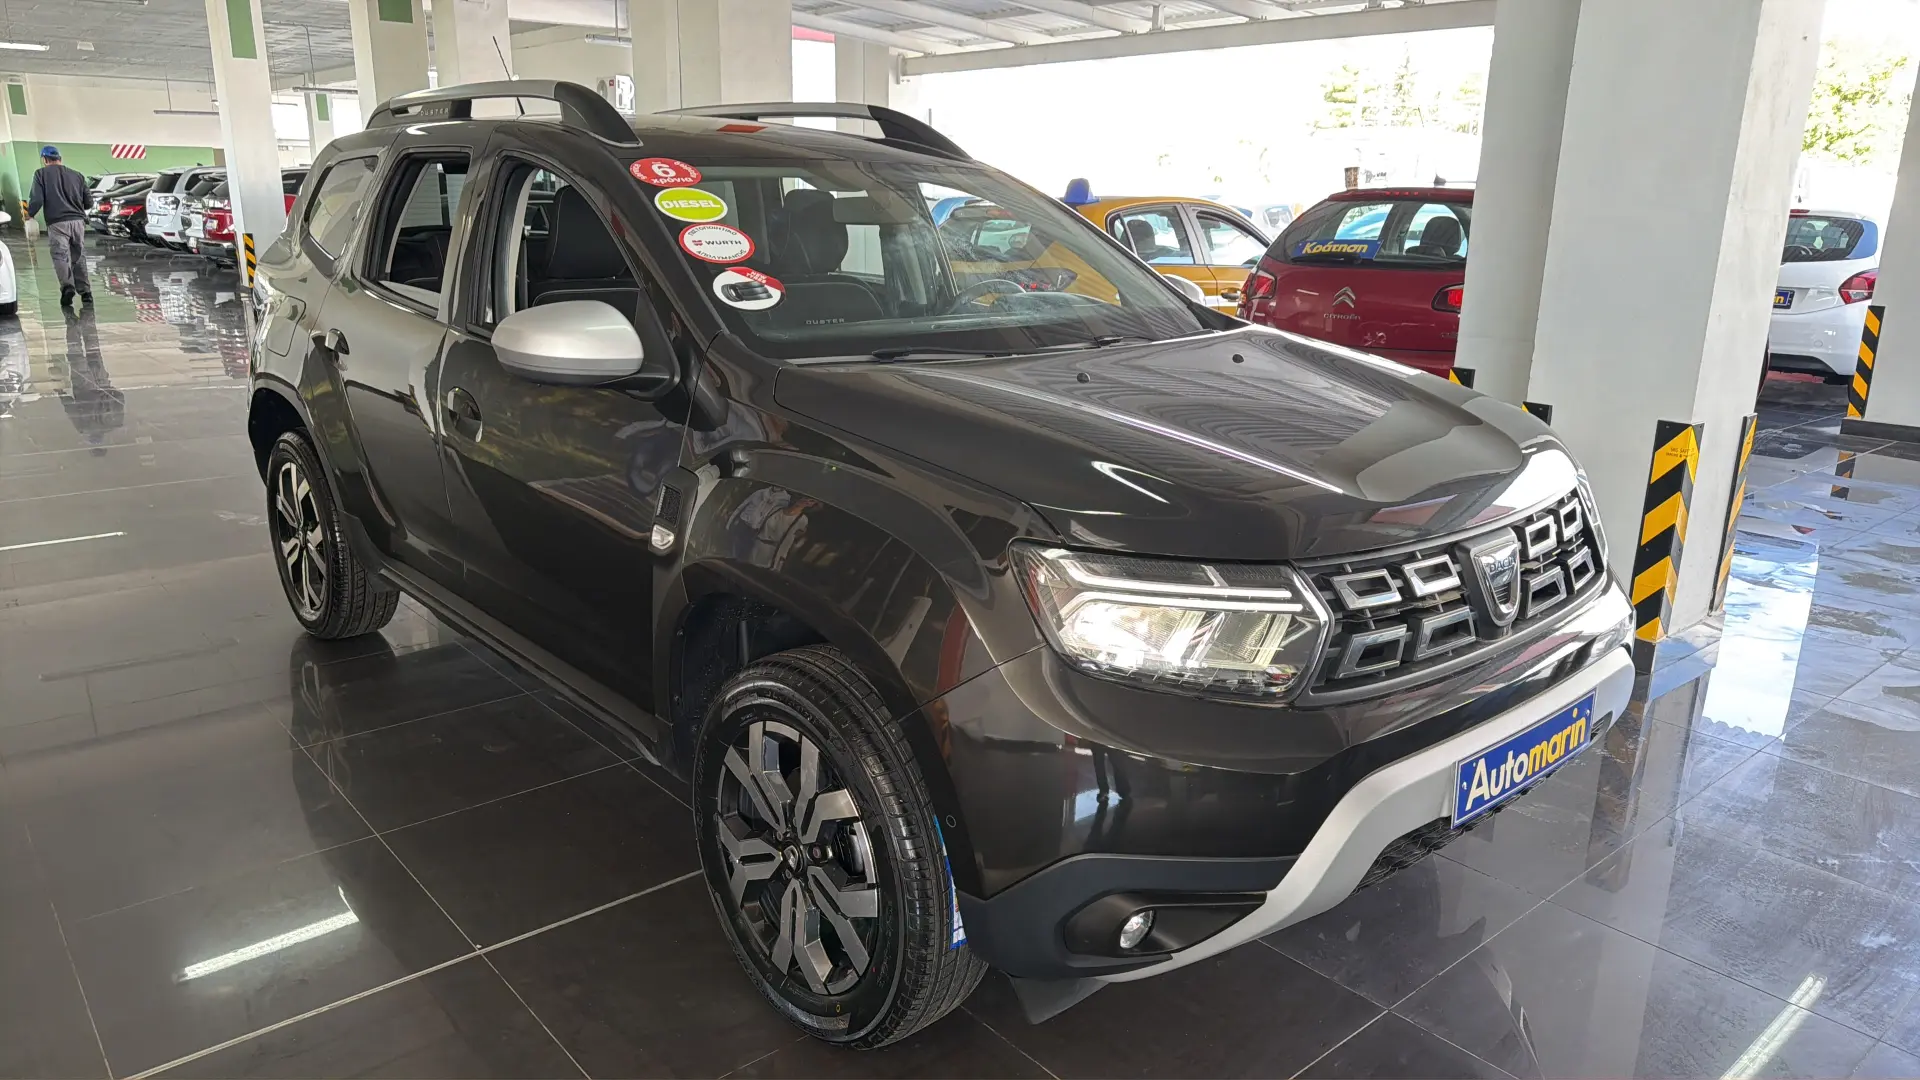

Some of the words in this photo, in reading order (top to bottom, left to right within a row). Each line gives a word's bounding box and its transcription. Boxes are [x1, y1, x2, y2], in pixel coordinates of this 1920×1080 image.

[652, 163, 677, 178] 6
[661, 197, 721, 210] DIESEL
[1465, 708, 1587, 812] Automarin
